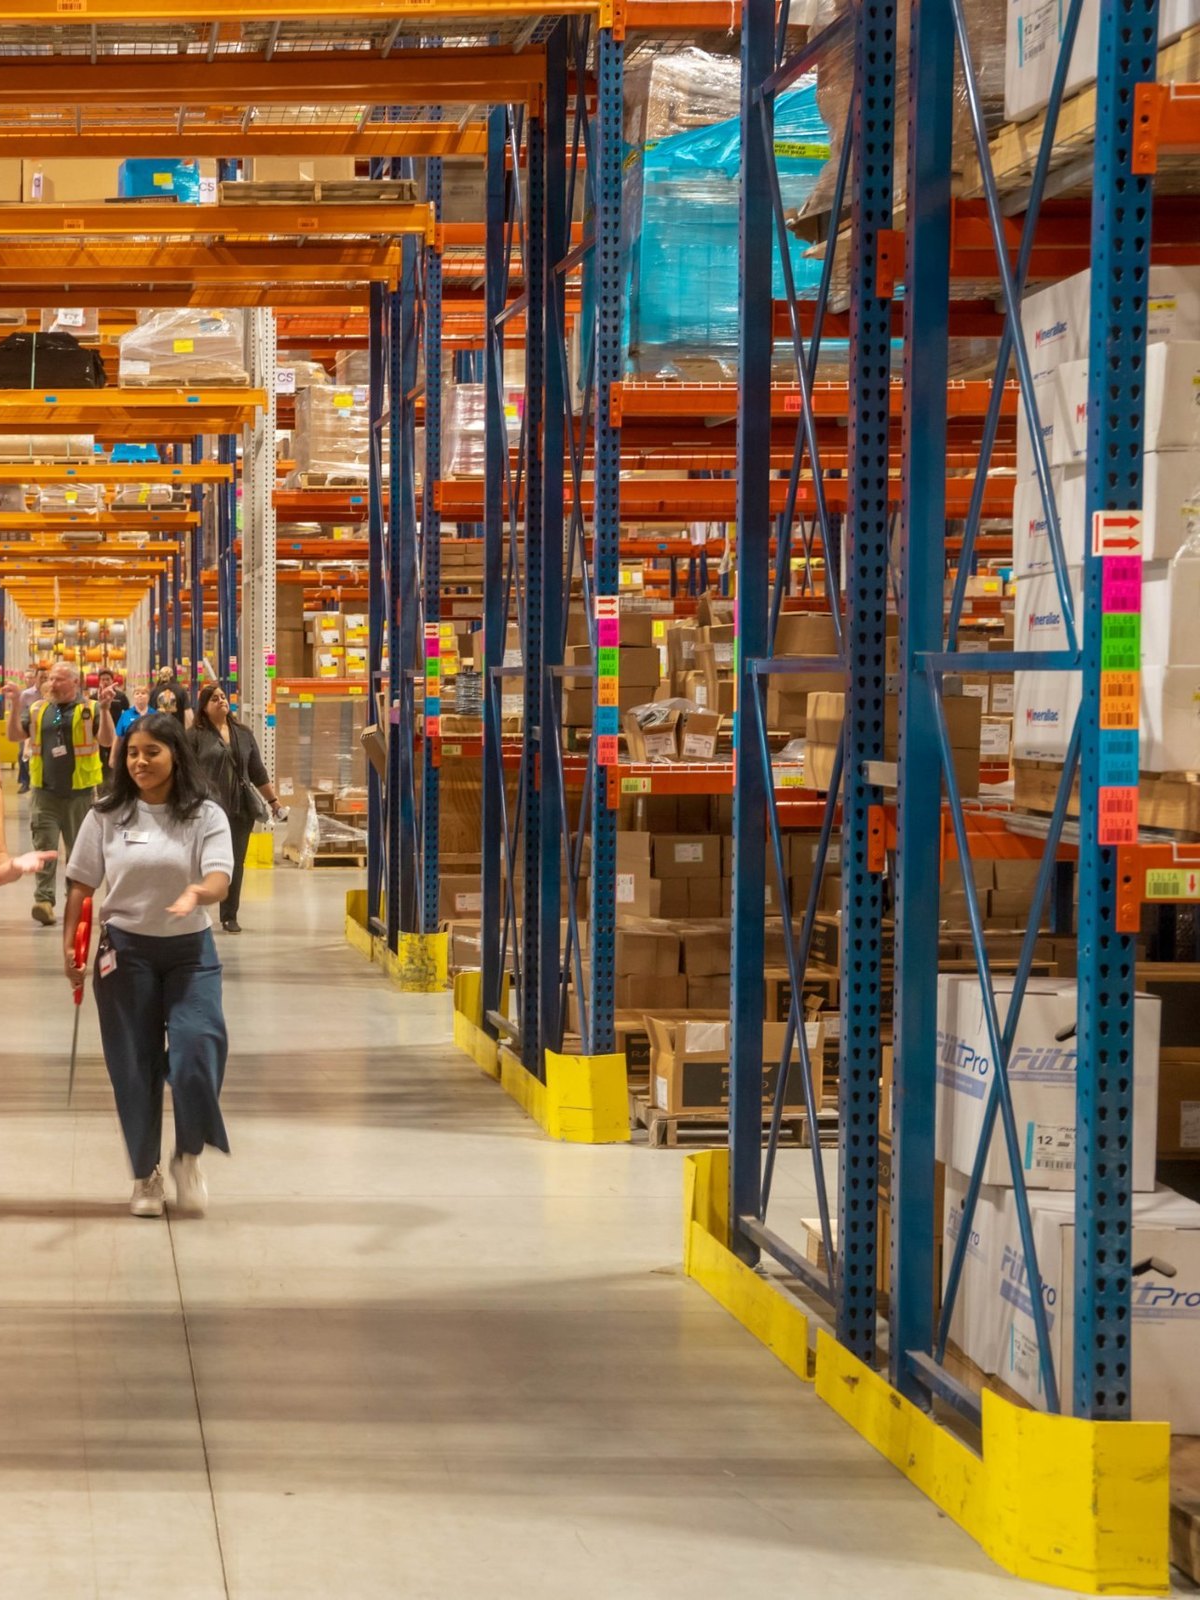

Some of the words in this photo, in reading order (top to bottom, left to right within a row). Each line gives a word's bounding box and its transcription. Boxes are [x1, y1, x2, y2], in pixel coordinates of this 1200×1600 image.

[200, 182, 216, 192] CS
[277, 372, 294, 382] CS
[1037, 1135, 1054, 1146] 12
